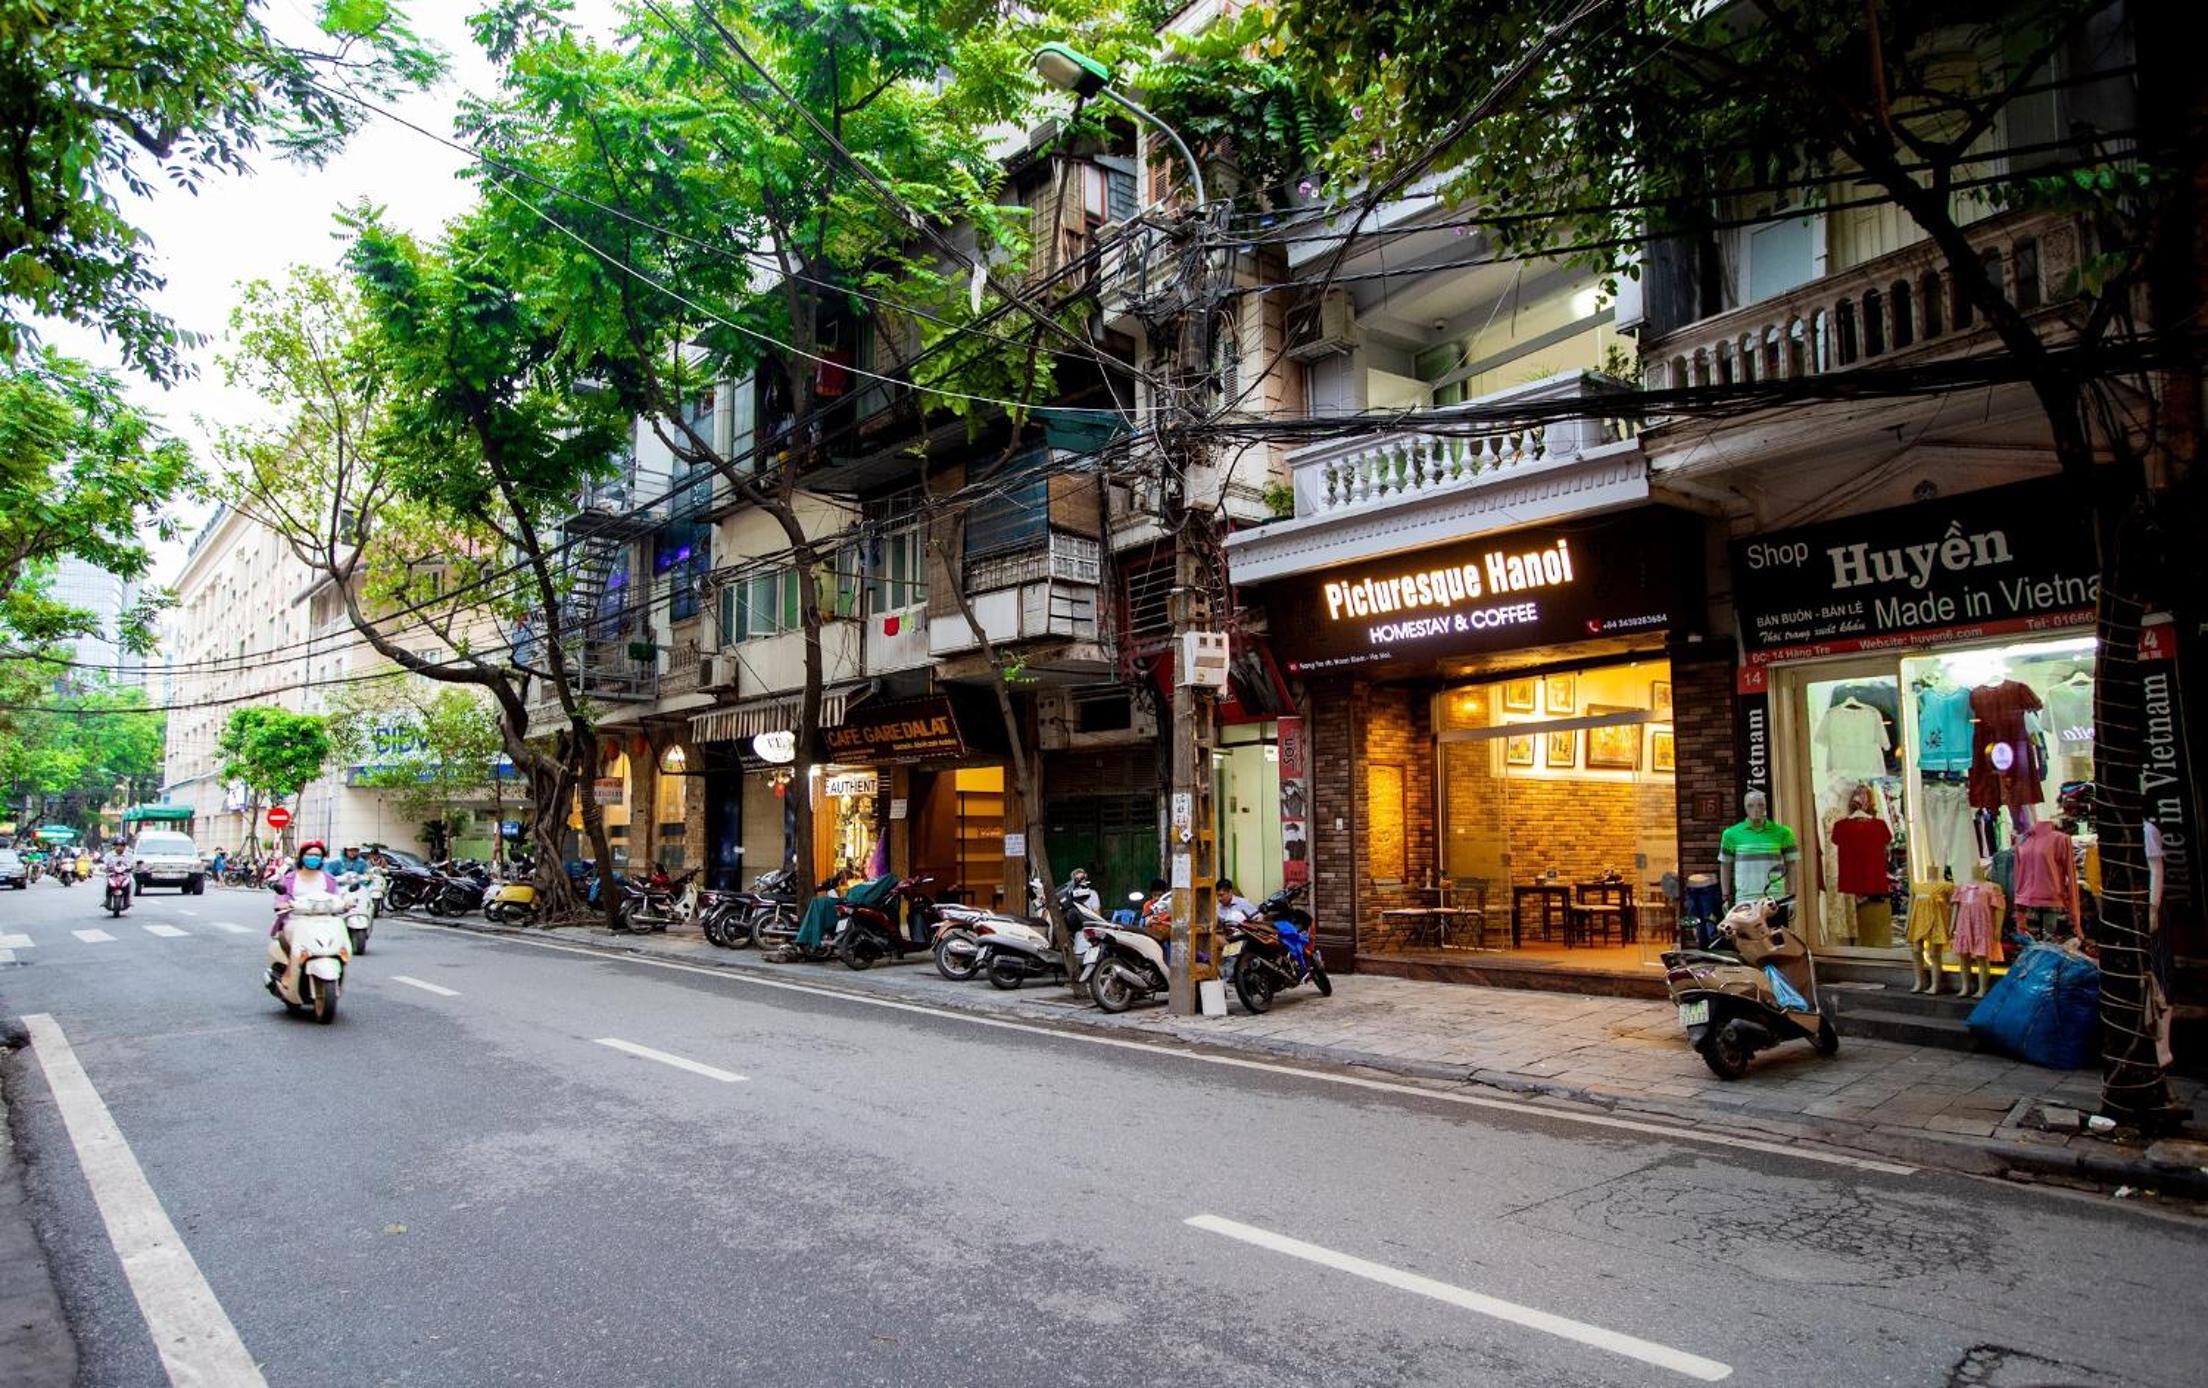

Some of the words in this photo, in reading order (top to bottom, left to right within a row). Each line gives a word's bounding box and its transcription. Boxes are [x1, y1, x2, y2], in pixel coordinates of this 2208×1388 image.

[1747, 540, 1809, 571] Shop
[1825, 520, 2014, 589] Huyền
[1324, 563, 1482, 620] Picturesque
[1484, 540, 1574, 593] Hanoi
[1756, 612, 1780, 629] BÁN
[1782, 608, 1814, 625] BUÔN
[1874, 588, 1956, 630] Made
[1964, 585, 1993, 618] in
[1369, 616, 1451, 644] HOMESTAY
[1454, 613, 1468, 630] &
[1470, 602, 1539, 629] COFFEE
[2025, 616, 2050, 632] Tel:
[1773, 649, 1785, 661] 14
[1859, 636, 1908, 651] Website:
[1743, 671, 1762, 687] 14
[863, 723, 904, 743] GARE
[902, 716, 949, 740] DALAT
[2140, 672, 2180, 795] Vietnam
[831, 779, 877, 794] AUTHENT
[1702, 800, 1716, 813] 16
[2151, 797, 2183, 825] in
